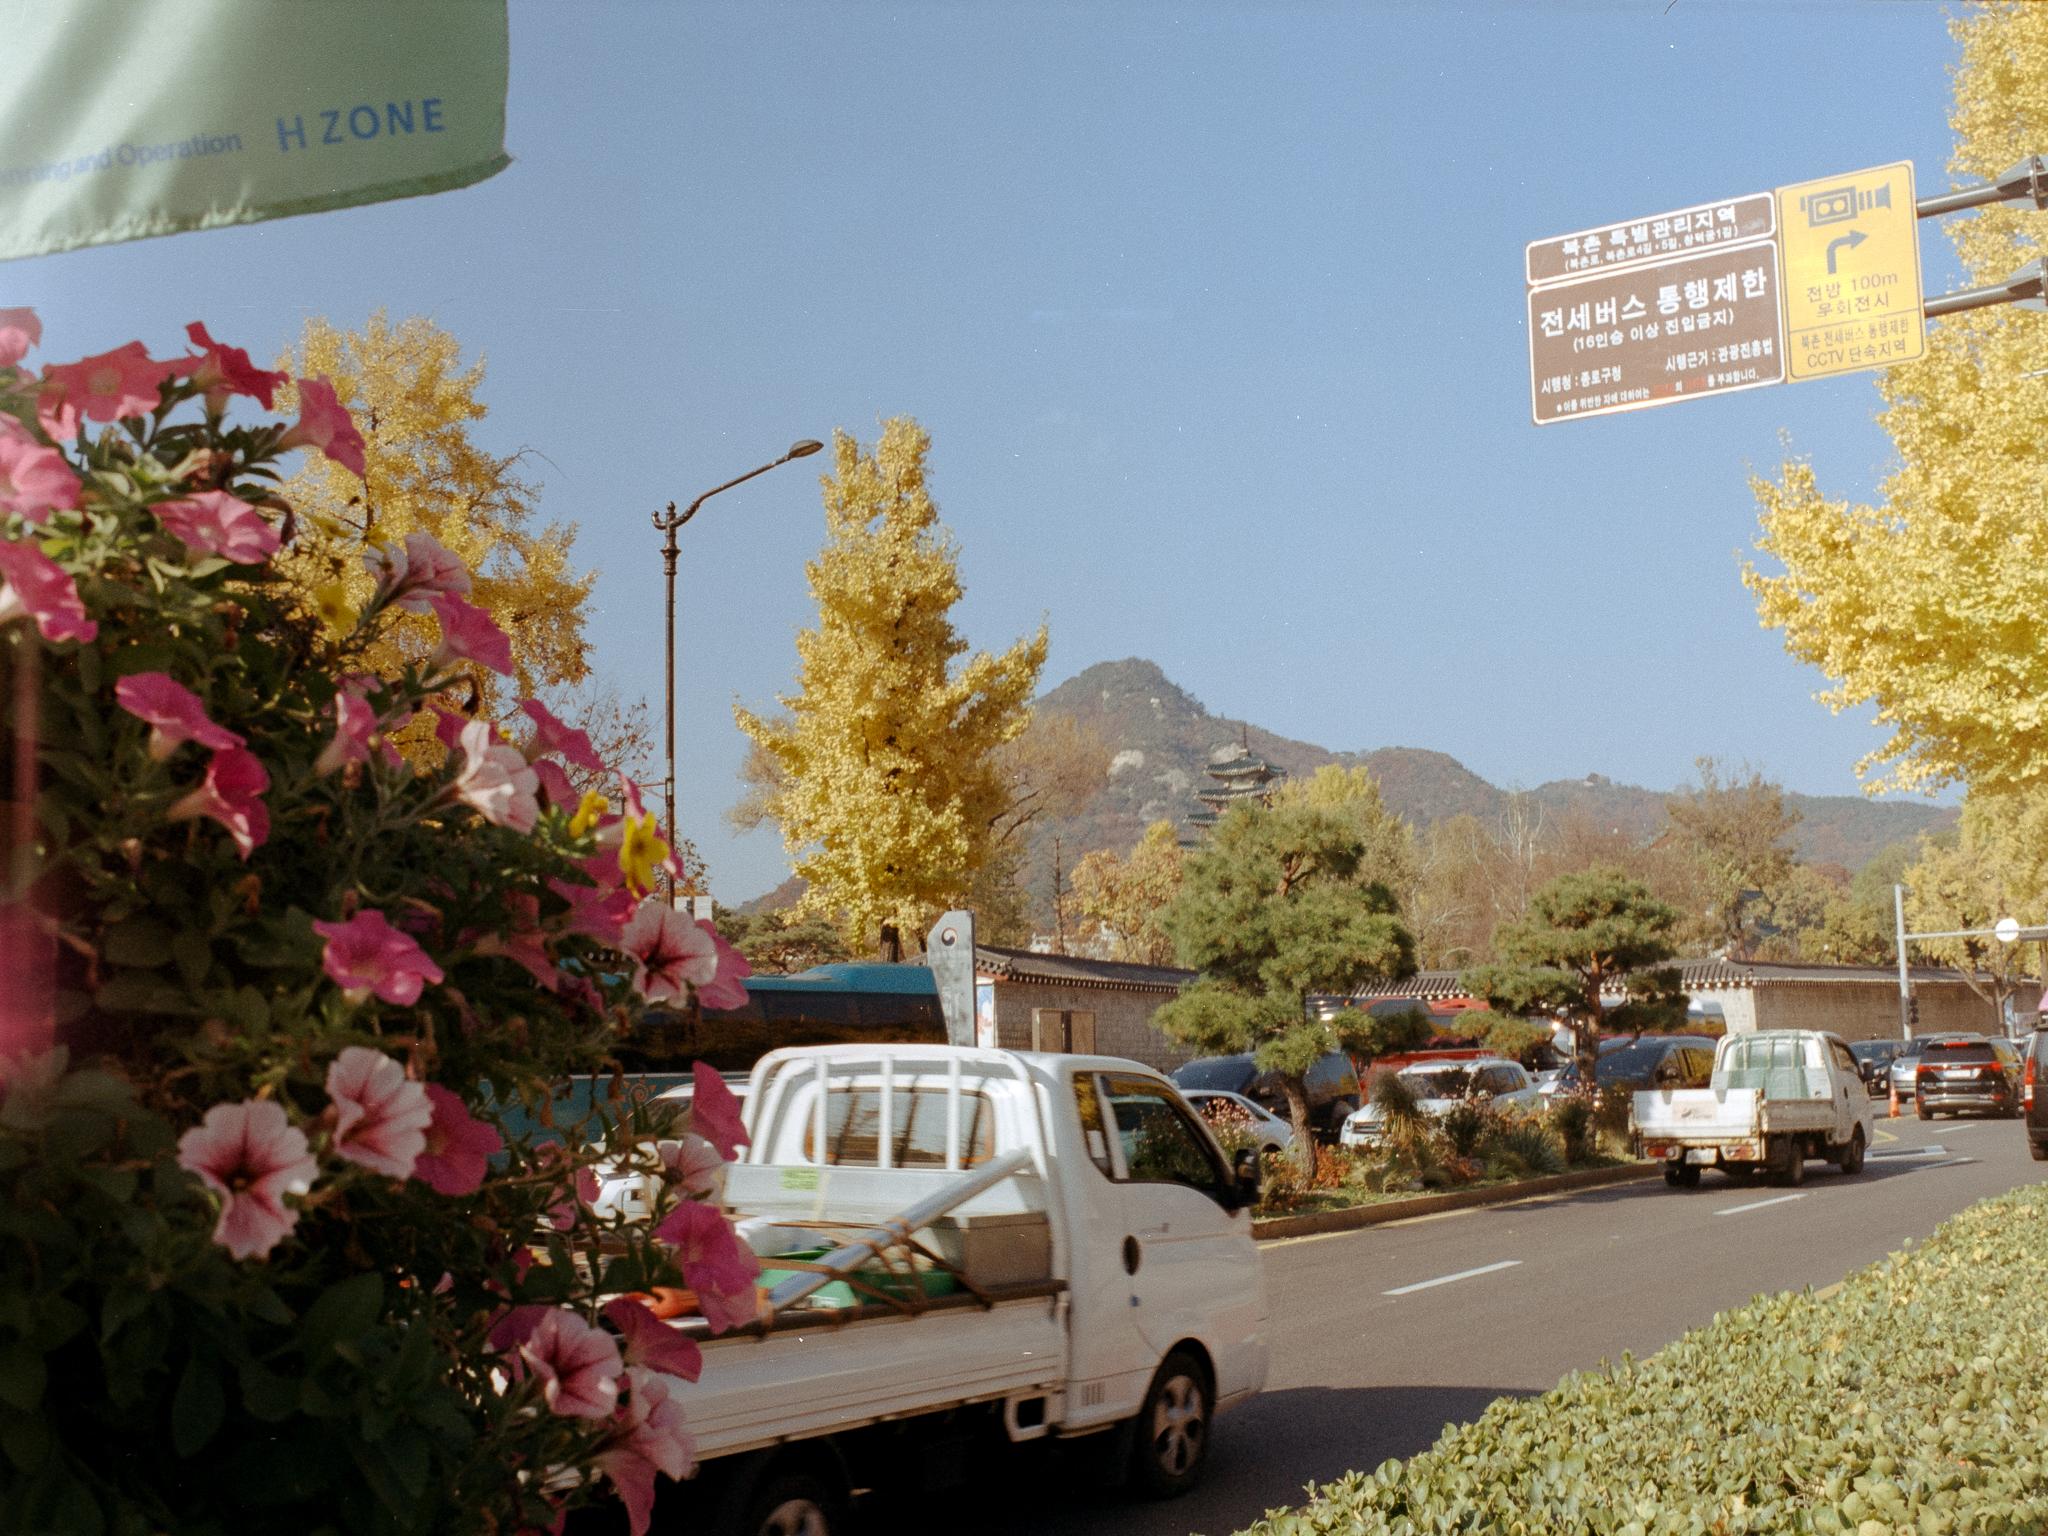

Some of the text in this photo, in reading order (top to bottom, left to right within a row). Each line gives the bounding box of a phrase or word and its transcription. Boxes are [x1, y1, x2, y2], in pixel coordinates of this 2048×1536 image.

[276, 97, 447, 152] H ZONE
[115, 131, 243, 168] Operation
[1562, 234, 1602, 257] 북촌
[1609, 205, 1737, 247] 특별관리지역
[1852, 272, 1899, 291] 100m
[1540, 266, 1768, 338] 전세버스 통행제한
[1816, 291, 1889, 317] 우회전시
[1573, 308, 1735, 353] (16인승 이상 진입금지)
[1665, 348, 1709, 372] 시행근거
[1807, 338, 1906, 368] CCTV 단속지역
[1580, 364, 1623, 388] 종로구청
